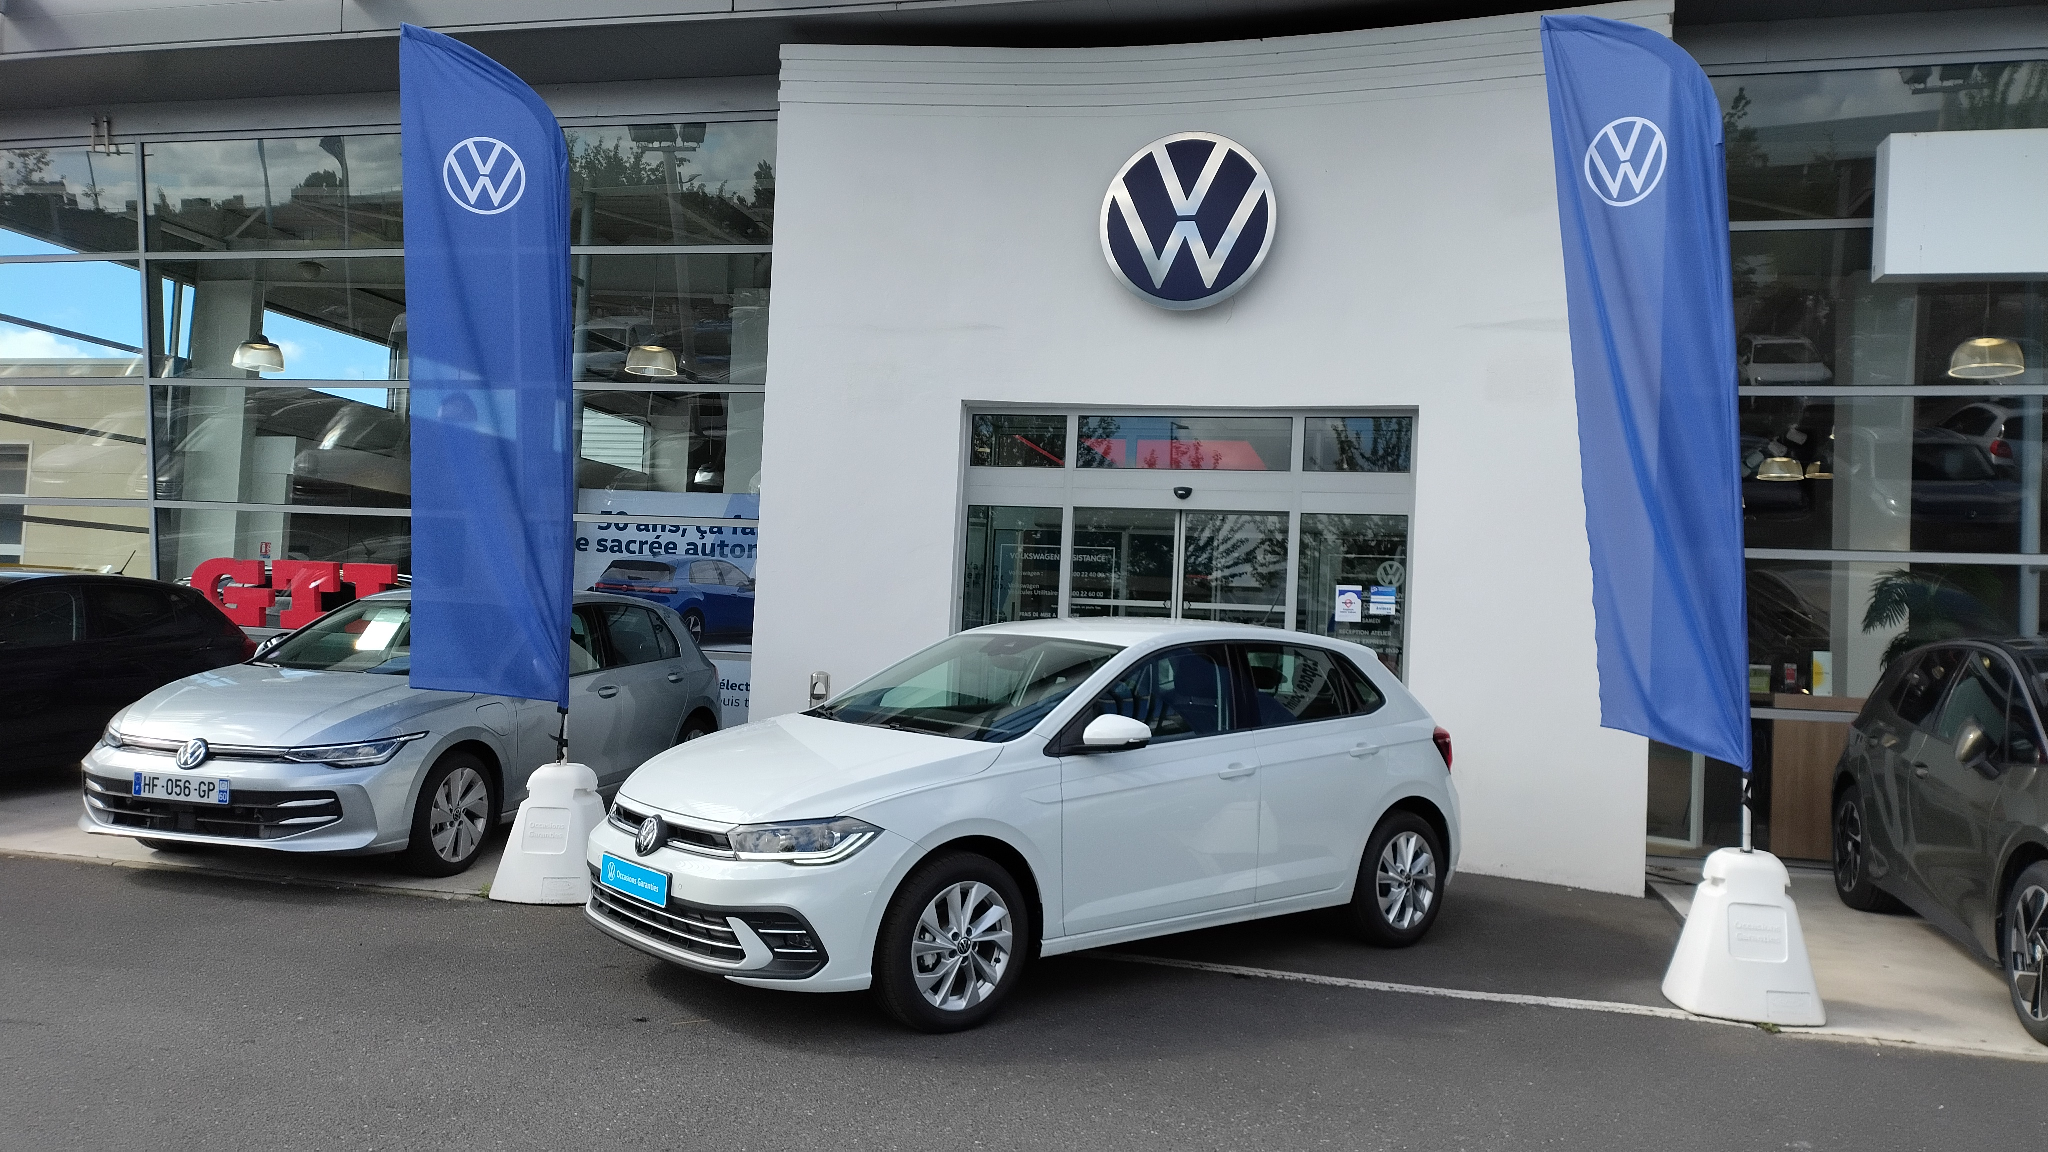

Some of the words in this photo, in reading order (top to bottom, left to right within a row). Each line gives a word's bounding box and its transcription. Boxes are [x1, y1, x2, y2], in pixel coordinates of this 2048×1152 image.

[732, 515, 758, 536] fa
[596, 534, 677, 555] sacrée
[1009, 552, 1060, 561] VOLKSWAGEN
[1072, 554, 1107, 562] SISTANCE
[719, 678, 750, 692] élect
[616, 870, 637, 885] Occasions
[637, 877, 659, 893] Garanties
